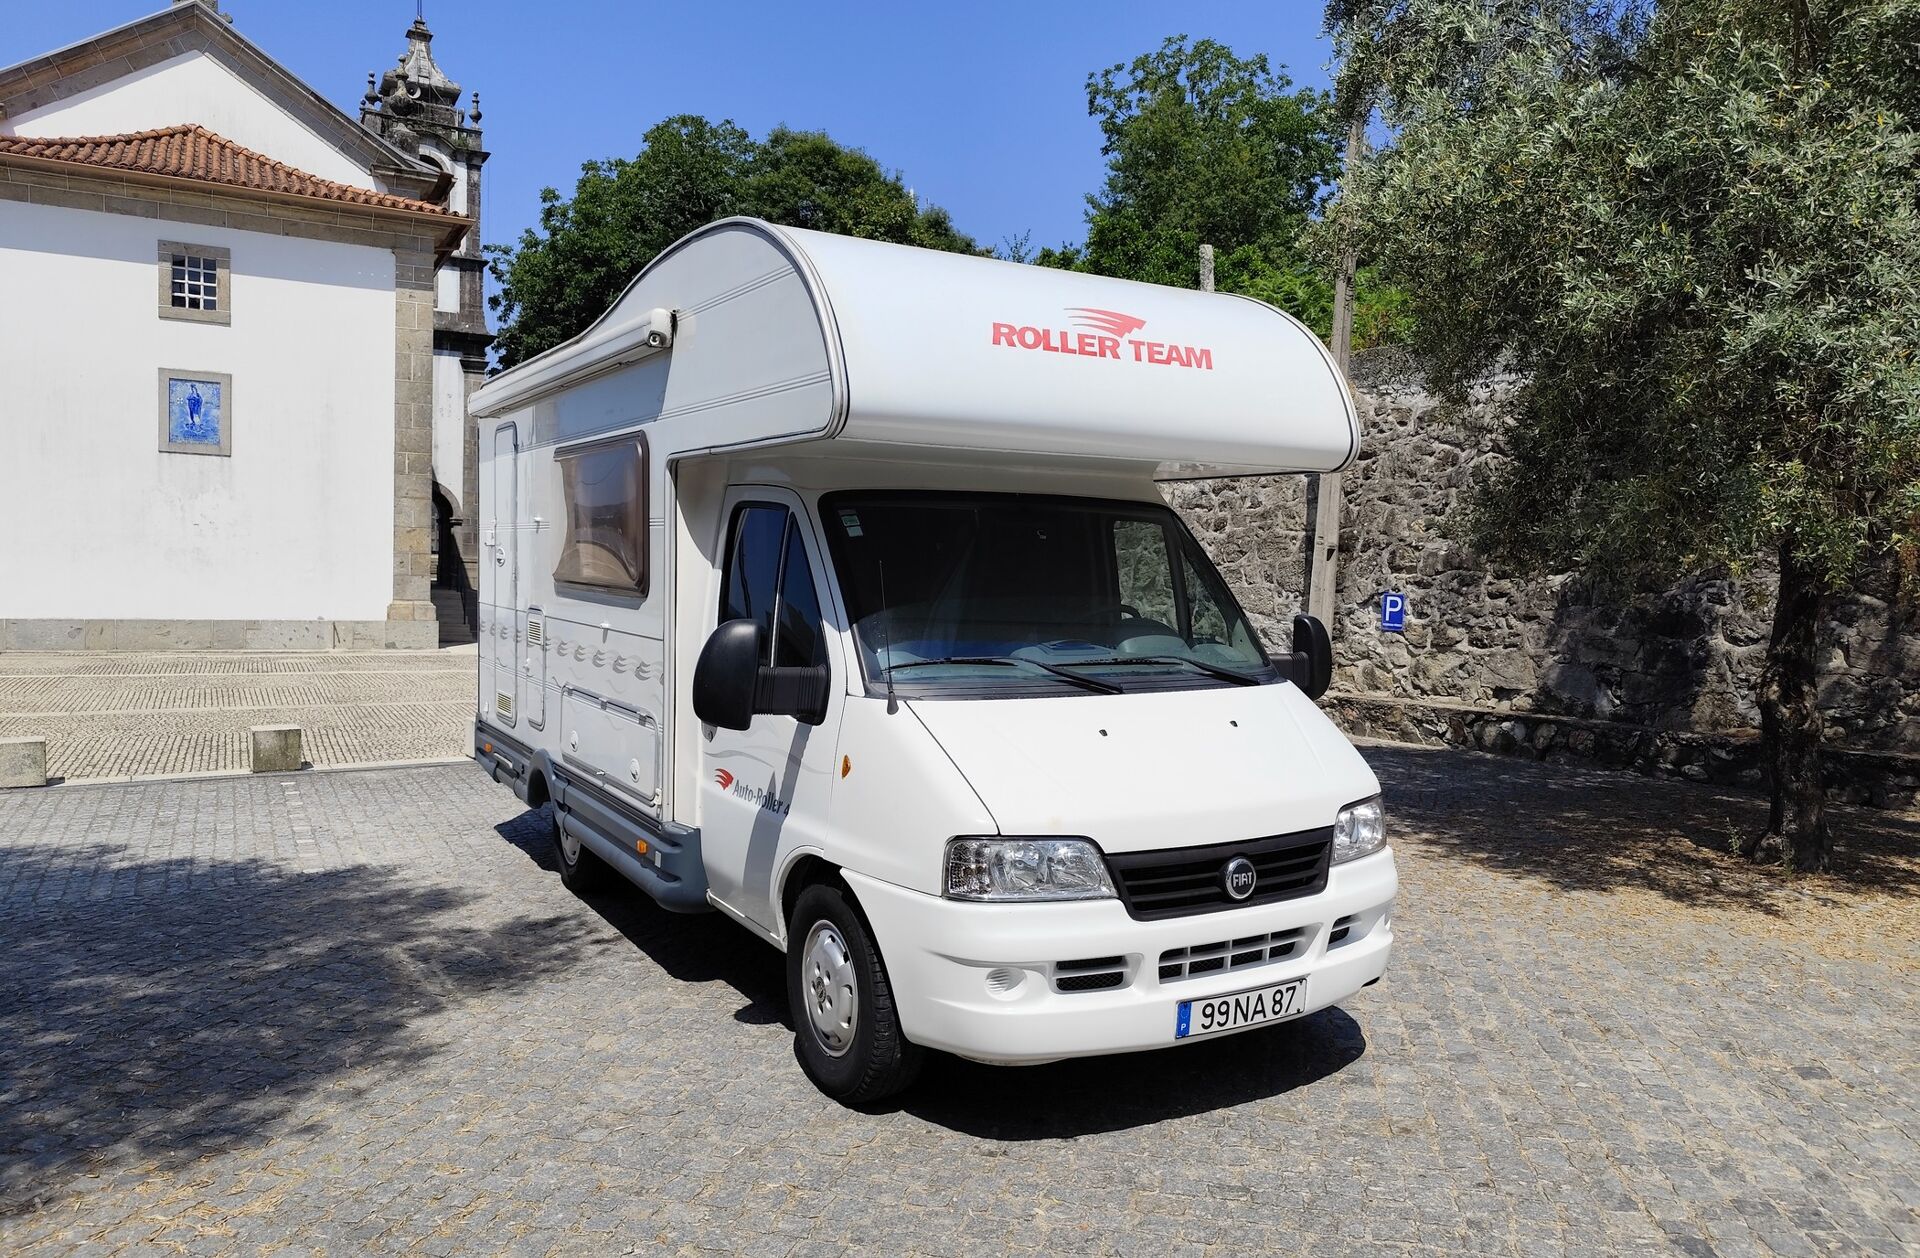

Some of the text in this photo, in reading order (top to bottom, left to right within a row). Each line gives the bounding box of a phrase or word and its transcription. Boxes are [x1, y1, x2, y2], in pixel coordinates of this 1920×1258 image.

[992, 322, 1214, 370] ROLLER TEAM
[1385, 596, 1402, 621] P
[732, 779, 784, 815] Auto-Roller
[1232, 871, 1253, 888] FIAT
[1180, 1023, 1187, 1031] P
